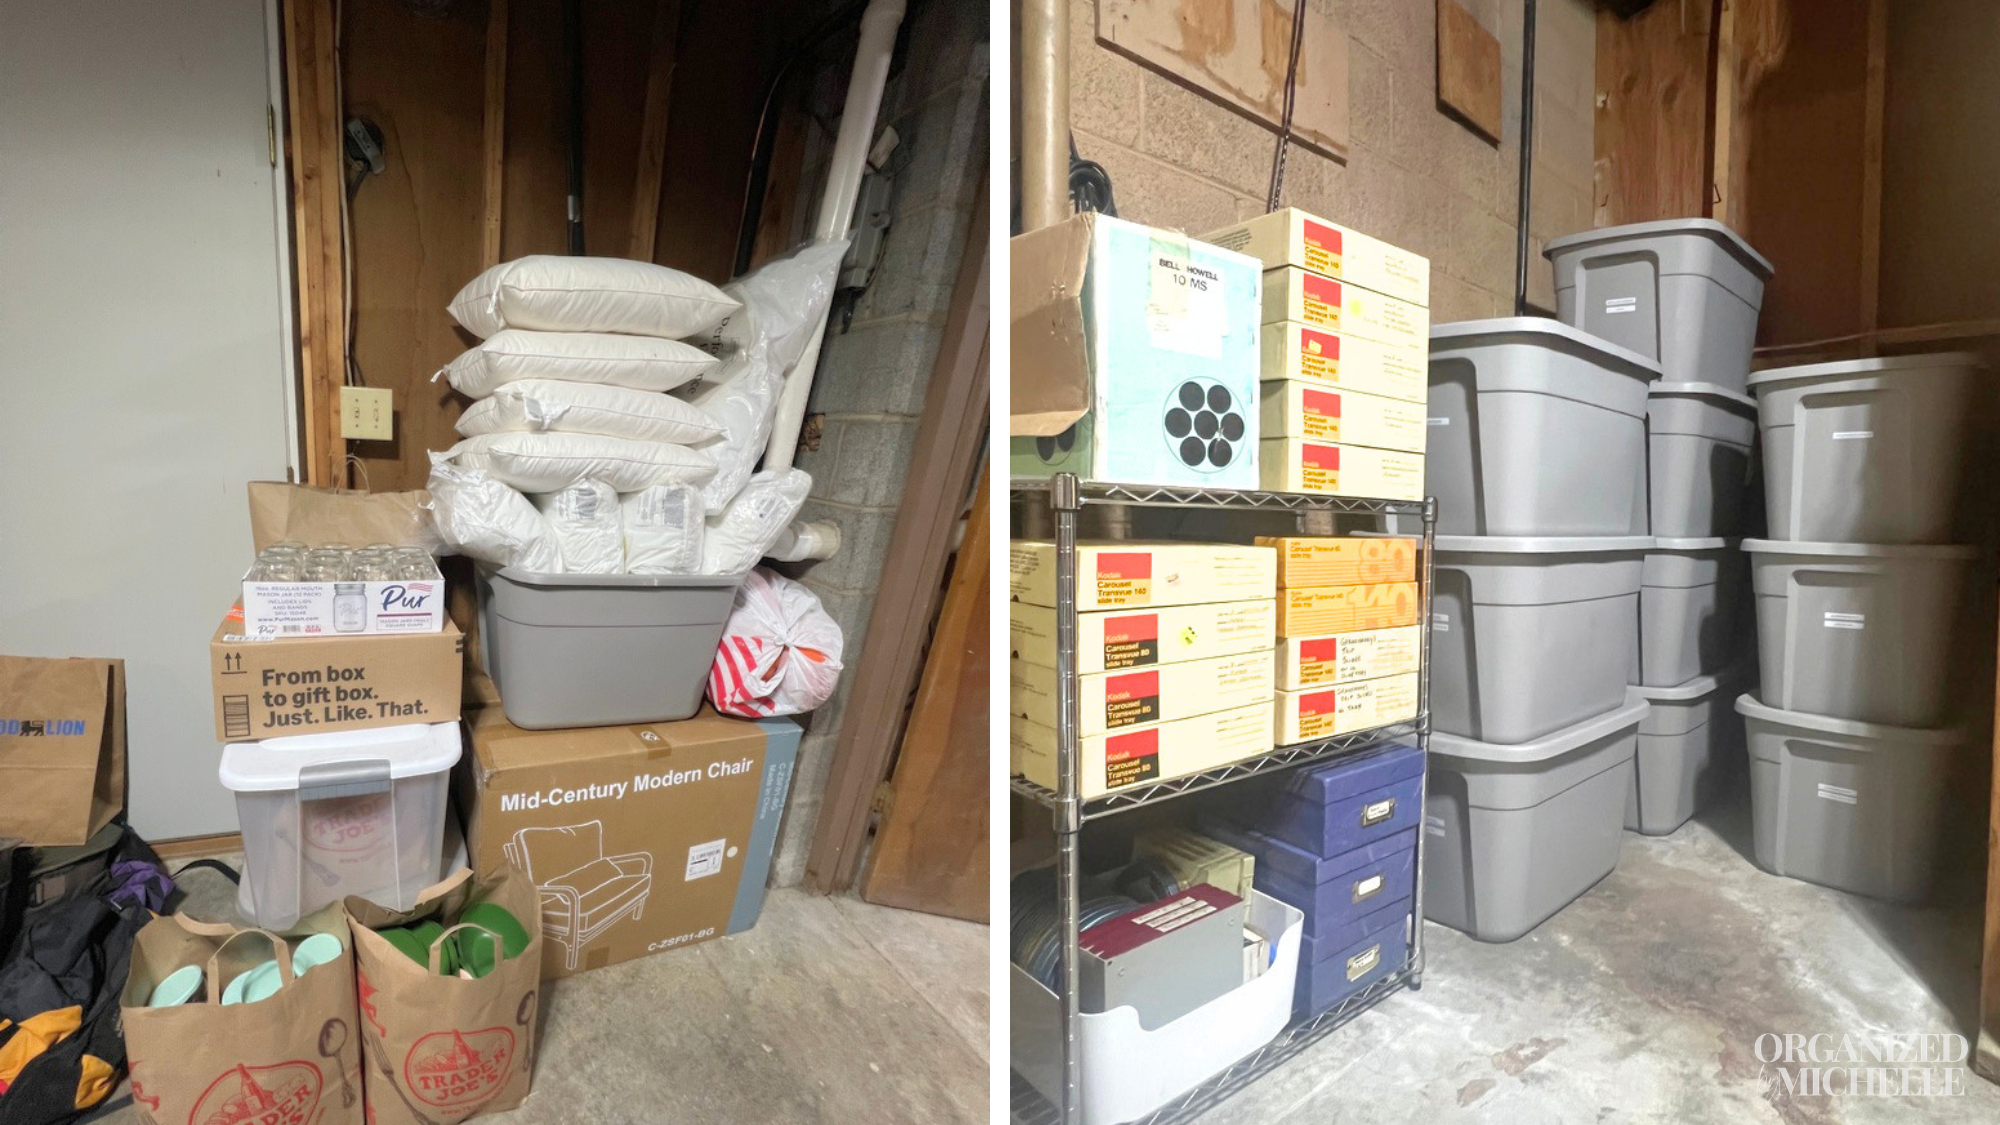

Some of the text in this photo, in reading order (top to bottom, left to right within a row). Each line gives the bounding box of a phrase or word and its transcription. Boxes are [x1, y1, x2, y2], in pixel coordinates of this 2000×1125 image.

[1159, 258, 1218, 281] BELL HOWELL
[1173, 274, 1208, 292] 10 MS
[1097, 581, 1132, 589] Carousel
[1097, 589, 1132, 597] Transvue
[381, 584, 431, 612] Pur
[1105, 634, 1129, 642] Kodak
[1105, 643, 1140, 652] Carousel
[1106, 651, 1140, 661] Transvue
[262, 665, 366, 687] From box
[263, 686, 379, 708] to gift box.
[1107, 692, 1131, 700] Kodak
[263, 699, 429, 728] Just. Like. That.
[1107, 700, 1141, 712] Carousel
[46, 719, 86, 736] LION
[1107, 752, 1131, 761] Kodak
[1107, 760, 1140, 772] Carousel
[500, 757, 754, 812] Mid-Century Modern Chair
[419, 1048, 506, 1090] TRADER
[436, 1070, 498, 1100] JOE'S
